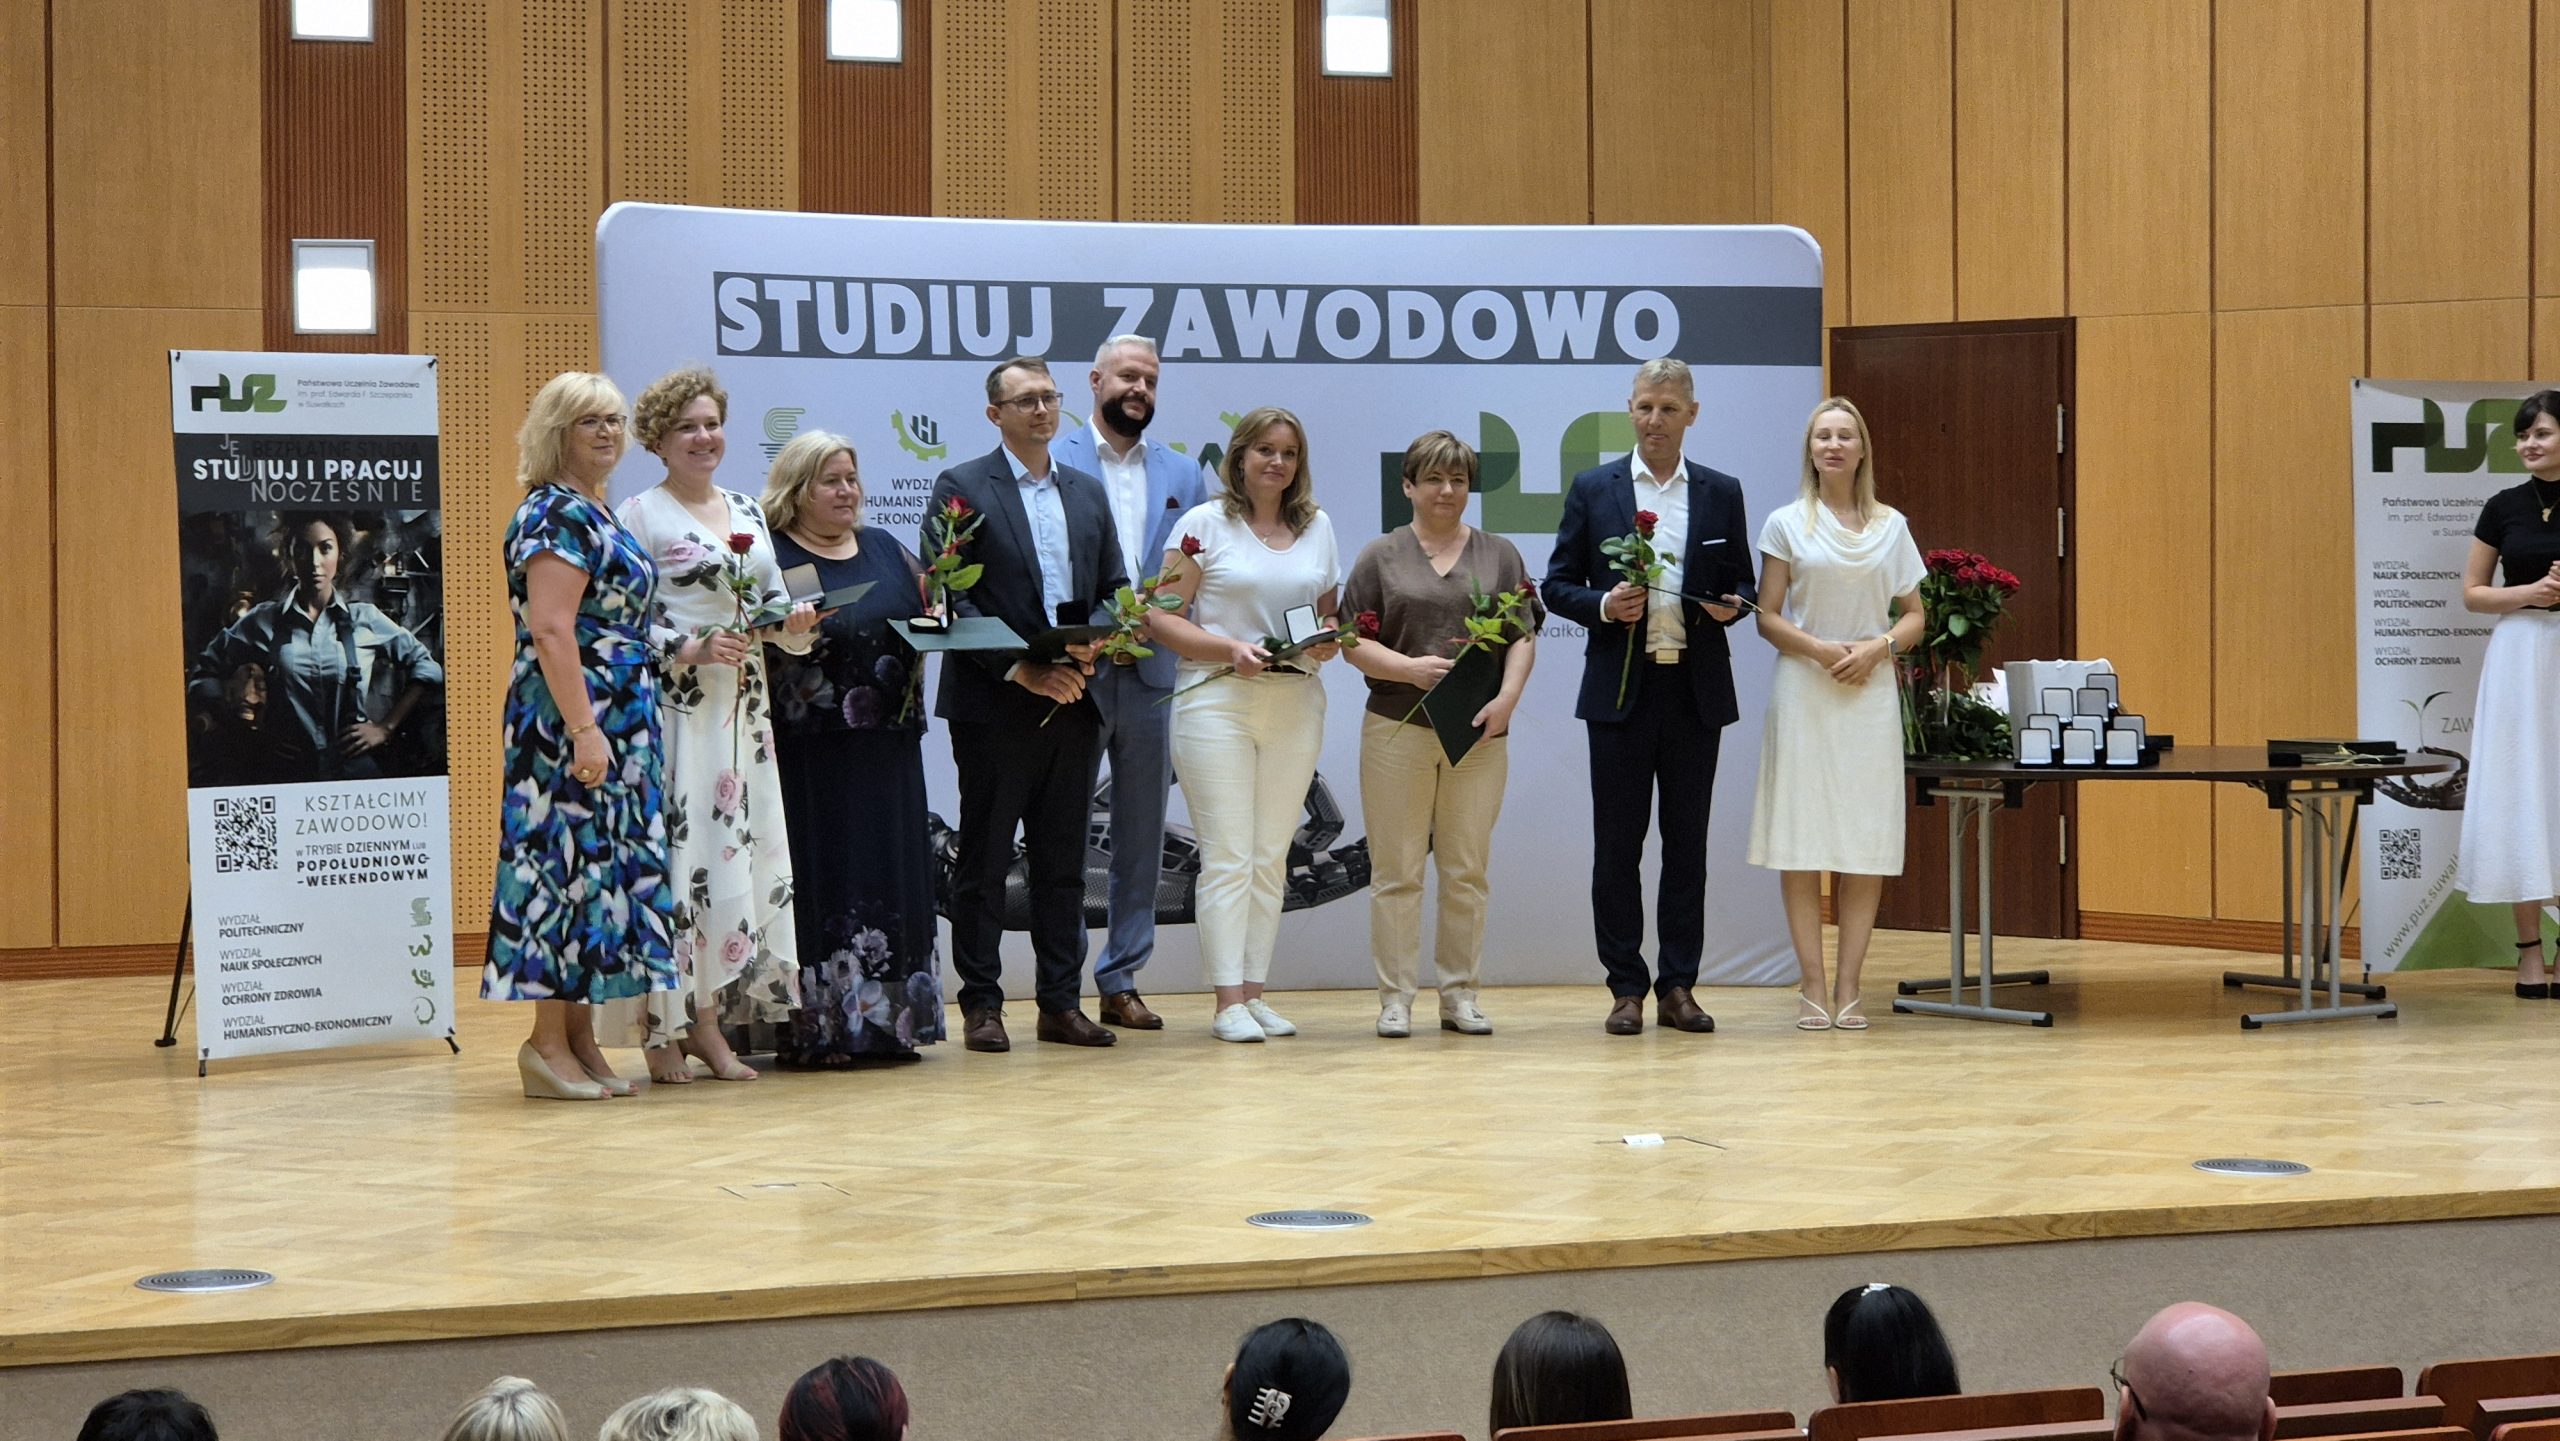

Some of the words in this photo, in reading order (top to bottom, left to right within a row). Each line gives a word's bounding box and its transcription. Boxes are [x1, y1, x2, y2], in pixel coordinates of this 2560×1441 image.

[718, 276, 1052, 358] STUDIUJ
[1104, 288, 1681, 361] ZAWODOWO
[297, 379, 342, 388] Państwowa
[344, 380, 377, 388] Uczelnia
[379, 380, 420, 389] Zawodowa
[307, 459, 314, 480] I
[324, 458, 422, 480] PRACUJ
[891, 478, 933, 490] WYDZI
[865, 496, 932, 507] HUMANIST
[2382, 497, 2440, 507] Państwowa
[2442, 497, 2484, 507] Uczelnia
[870, 512, 924, 524] -EKONO
[2428, 513, 2469, 522] Edwarda
[2373, 561, 2410, 570] WYDZIAŁ
[2373, 571, 2398, 580] NAUK
[2401, 571, 2461, 580] SPOŁECZNYCH
[2374, 589, 2411, 598] WYDZIAŁ
[2374, 599, 2447, 608] POLITECHNICZNY
[2374, 618, 2411, 627] WYDZIAŁ
[1537, 624, 1586, 639] wałka
[2375, 646, 2411, 656] WYDZIAŁ
[2375, 657, 2417, 666] OCHRONY
[2420, 657, 2461, 666] ZDROWIA
[2440, 717, 2474, 734] ZAW
[305, 791, 427, 813] KSZTAŁCIMY
[296, 812, 428, 835] ZAWODOWO!
[305, 843, 343, 856] TRYBIE
[346, 840, 410, 854] DZIENNYM
[297, 868, 428, 887] -WEEKENDOWYM
[218, 914, 261, 926] WYDZIAŁ
[219, 922, 304, 938] POLITECHNICZNY
[219, 948, 262, 960] WYDZIAŁ
[220, 961, 250, 973] NAUK
[252, 954, 322, 970] SPOŁECZNYCH
[221, 981, 264, 994] WYDZIAŁ
[222, 992, 272, 1006] OCHRONY
[274, 987, 323, 1001] ZDROWIA
[223, 1015, 266, 1028] WYDZIAŁ
[223, 1015, 393, 1041] HUMANISTYCZNO-EKONOMICZNY
